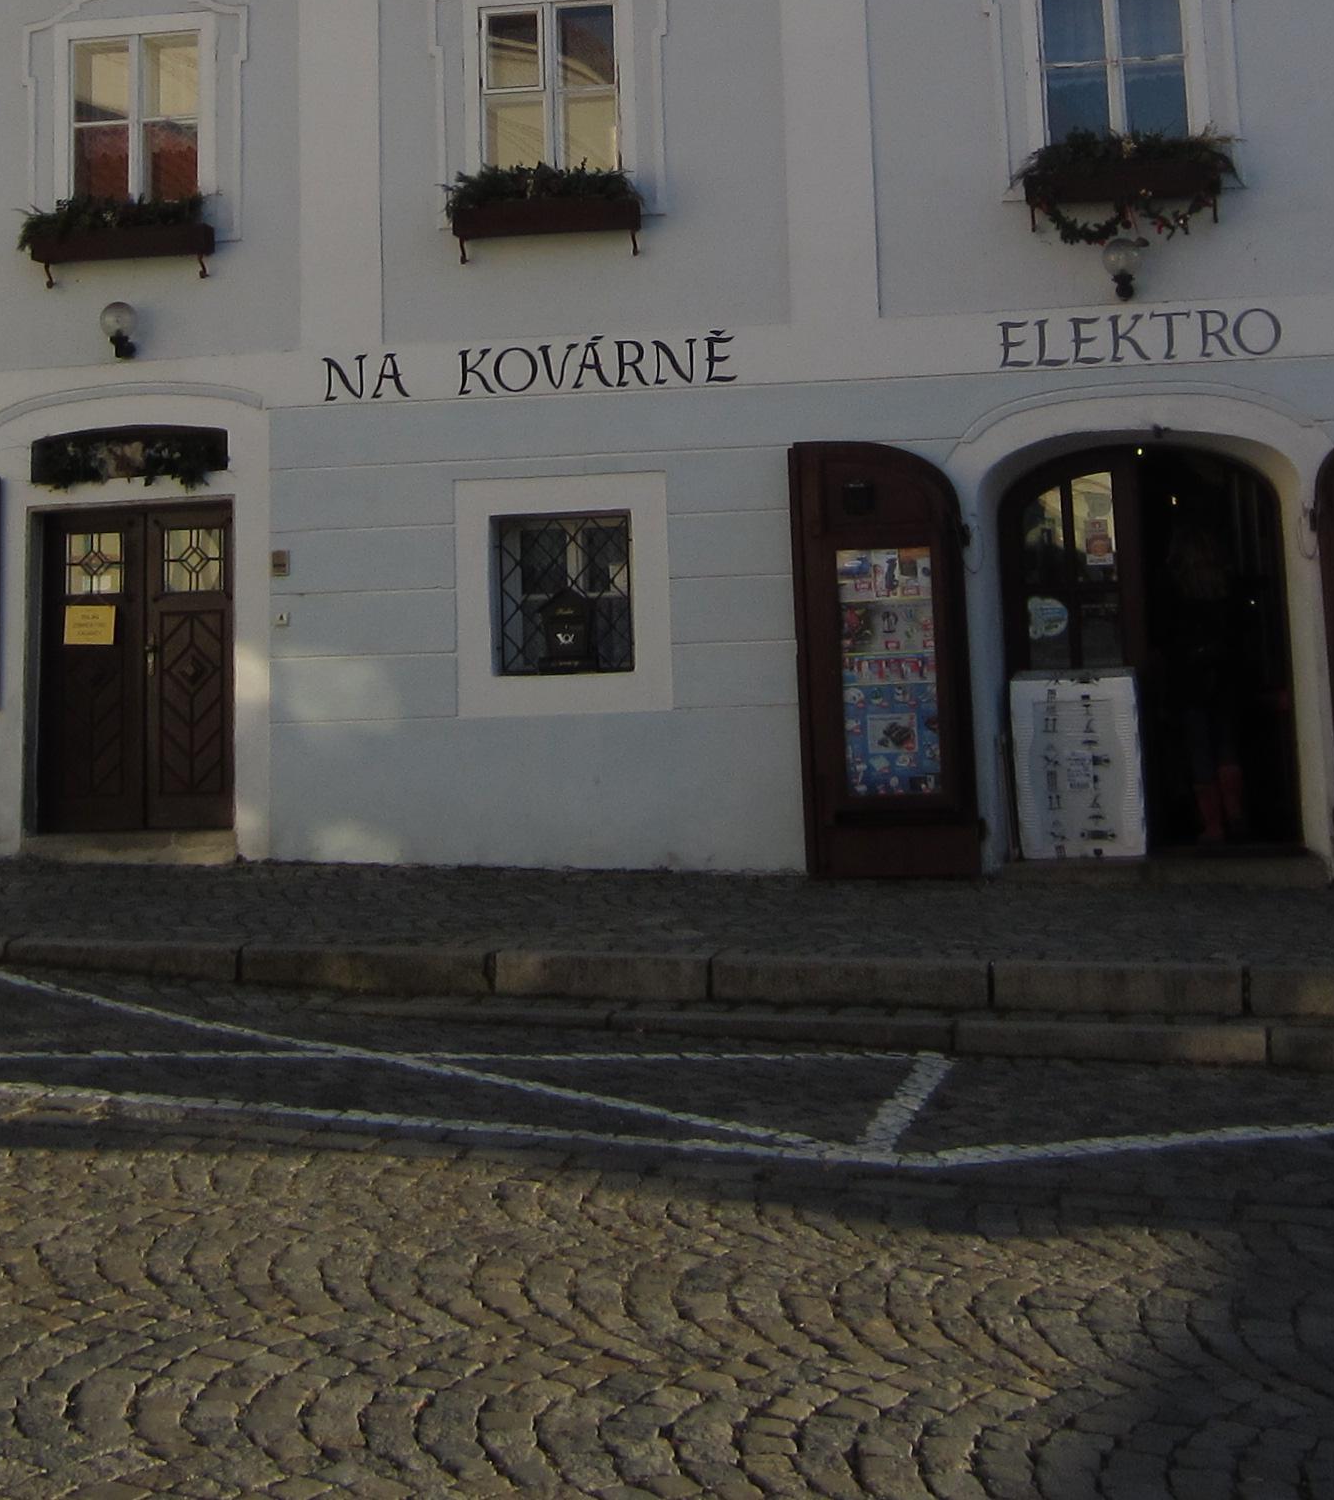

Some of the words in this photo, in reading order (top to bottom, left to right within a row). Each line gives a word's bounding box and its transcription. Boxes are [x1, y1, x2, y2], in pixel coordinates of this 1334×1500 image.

[322, 353, 410, 401] NA
[457, 329, 738, 396] KOVÁRNĚ
[997, 308, 1282, 369] ELEKTRO
